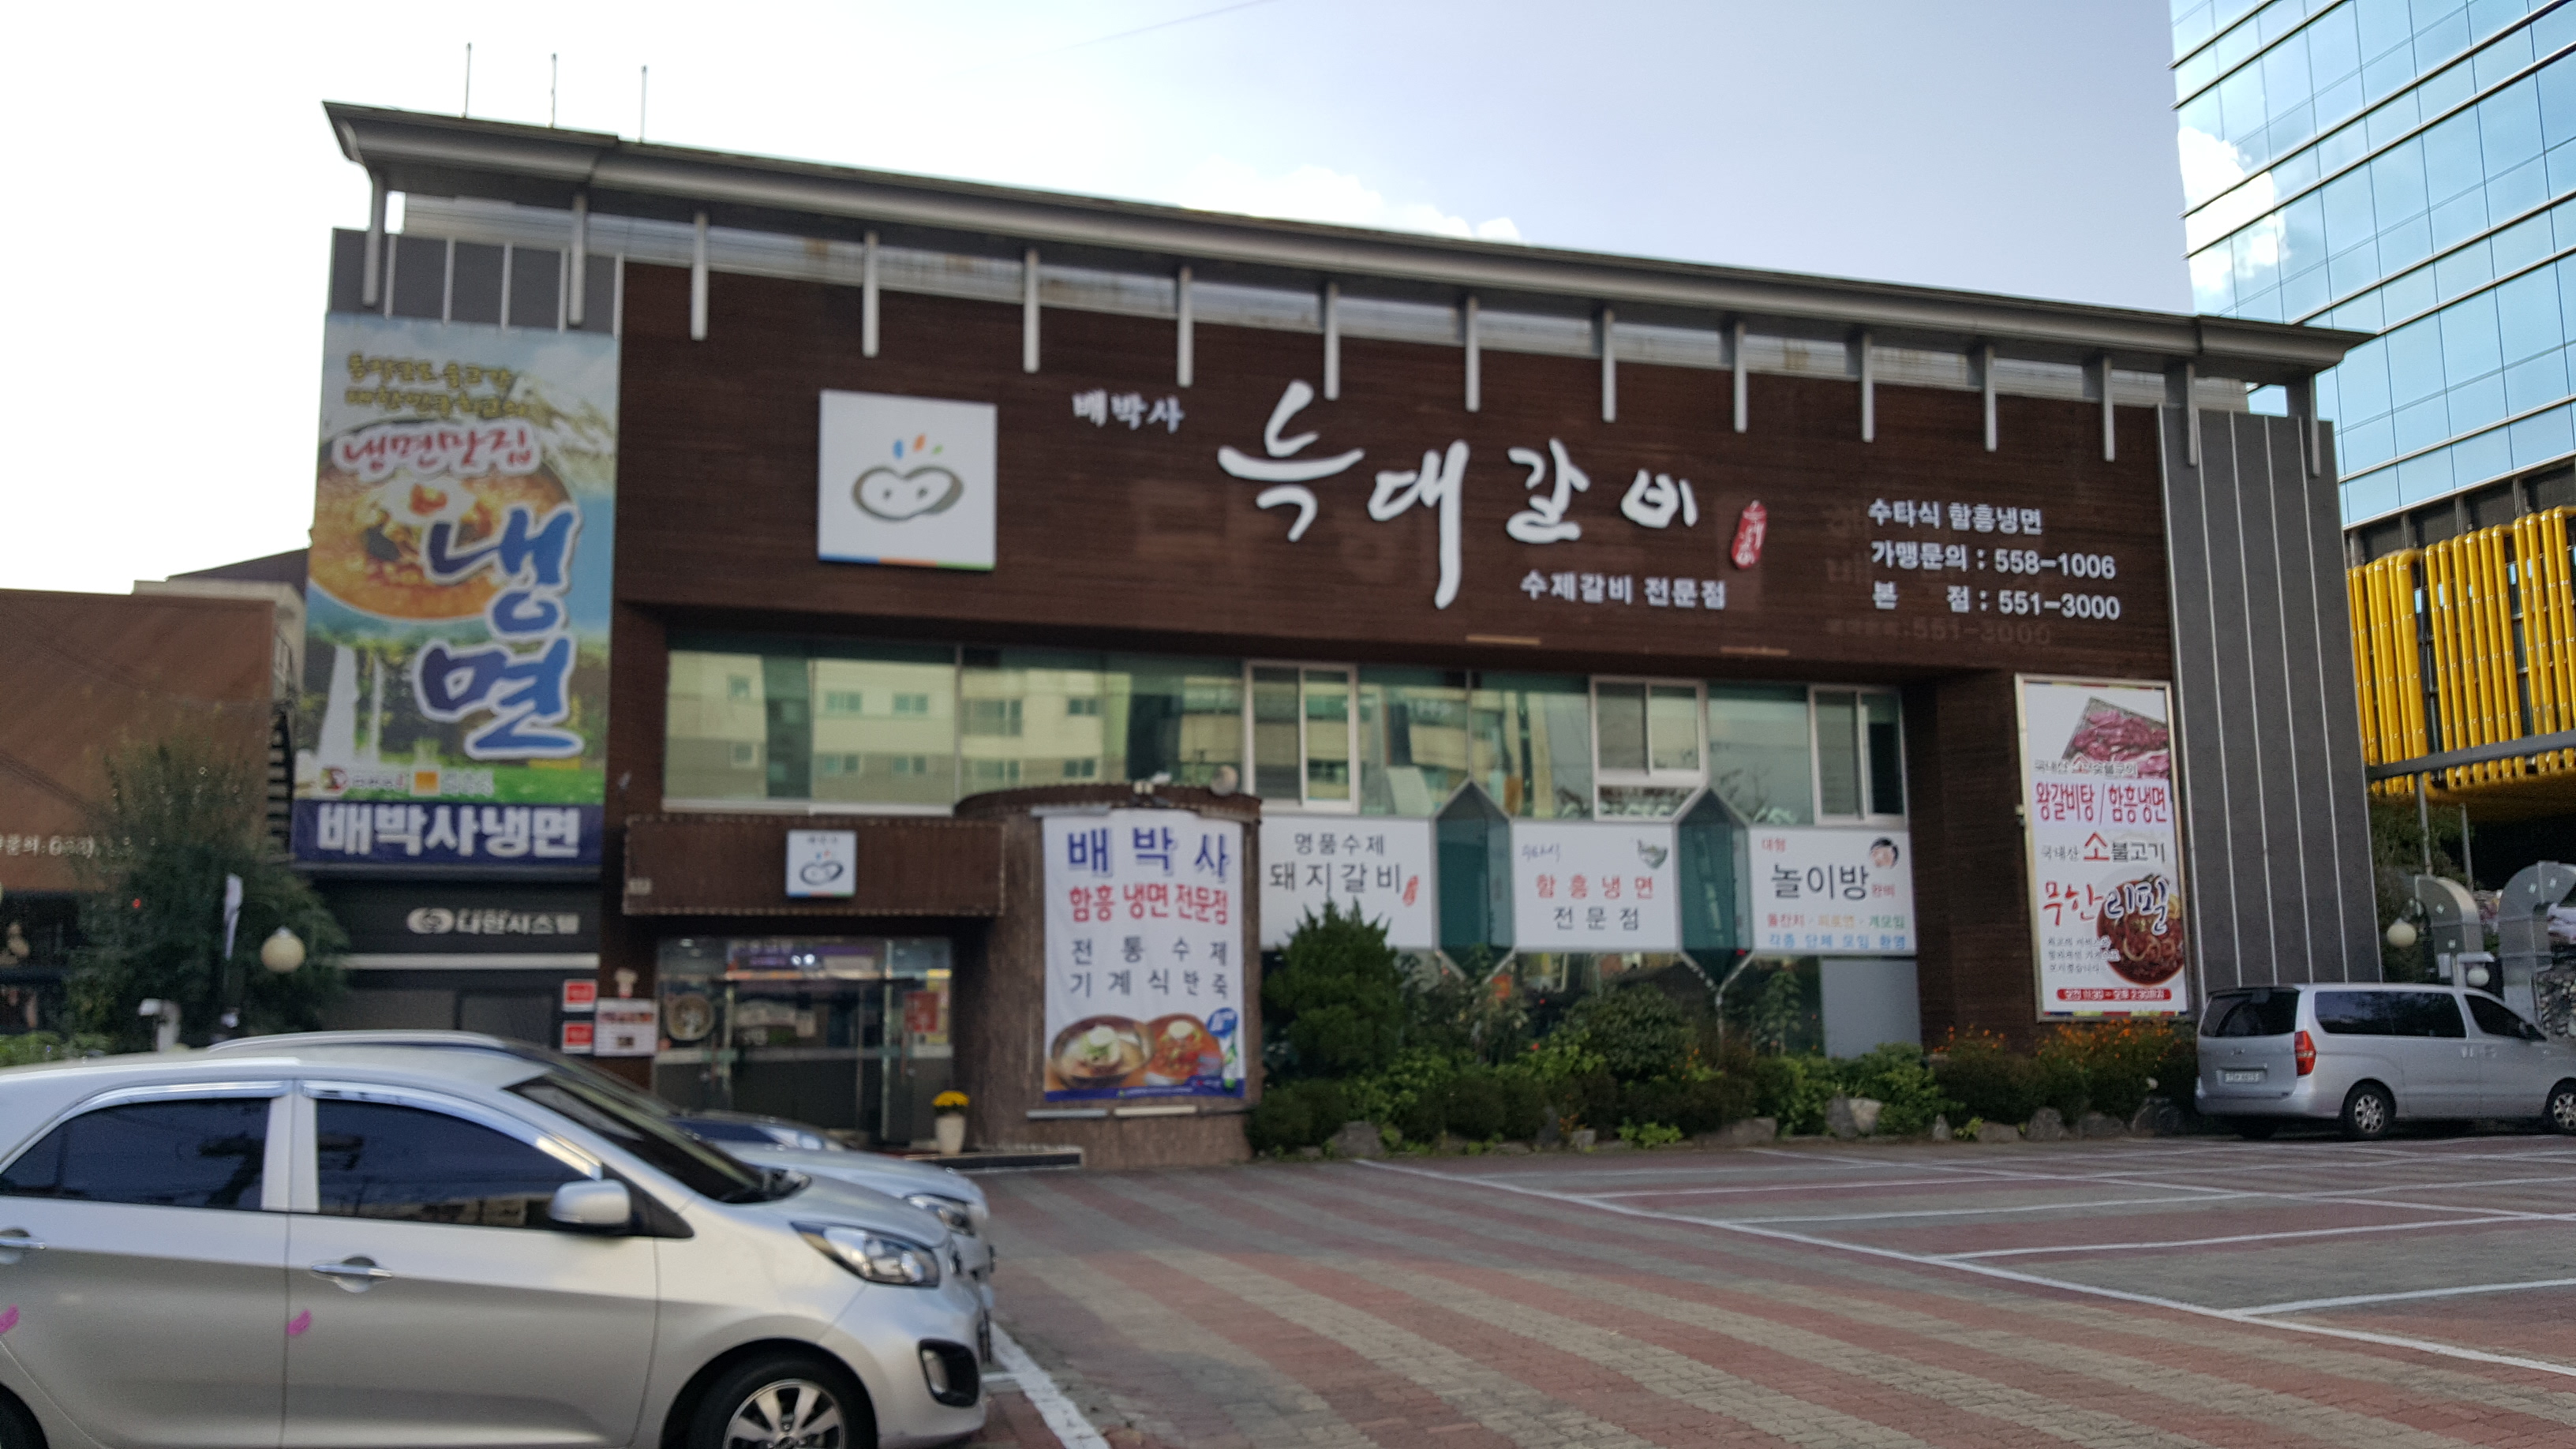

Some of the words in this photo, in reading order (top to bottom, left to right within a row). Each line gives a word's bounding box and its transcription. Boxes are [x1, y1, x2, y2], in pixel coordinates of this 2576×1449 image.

[1073, 391, 1185, 432] 배박사
[1218, 380, 1698, 609] 늑대갈비
[1867, 498, 1941, 530] 수타식
[1947, 502, 2042, 535] 함흥냉면
[1871, 540, 1968, 572] 가맹문의
[1994, 549, 2117, 580] 558-1006
[1520, 569, 1634, 605] 수제갈비
[1643, 577, 1728, 610] 전문점
[1998, 590, 2121, 621] 551-3000
[2035, 782, 2095, 822] 왕갈비탕
[2108, 783, 2167, 824] 함흥냉면
[317, 803, 582, 858] 배박사냉면
[1294, 833, 1384, 856] 명품수제
[1068, 826, 1229, 878] 배박사
[1269, 861, 1401, 894] 돼지갈비
[1537, 874, 1654, 900] 함흥냉면
[1771, 863, 1870, 901] 놀이방
[1069, 885, 1115, 923] 함흥
[1123, 883, 1169, 919] 냉면
[1175, 884, 1230, 926] 전문점
[1553, 907, 1639, 930] 전문점
